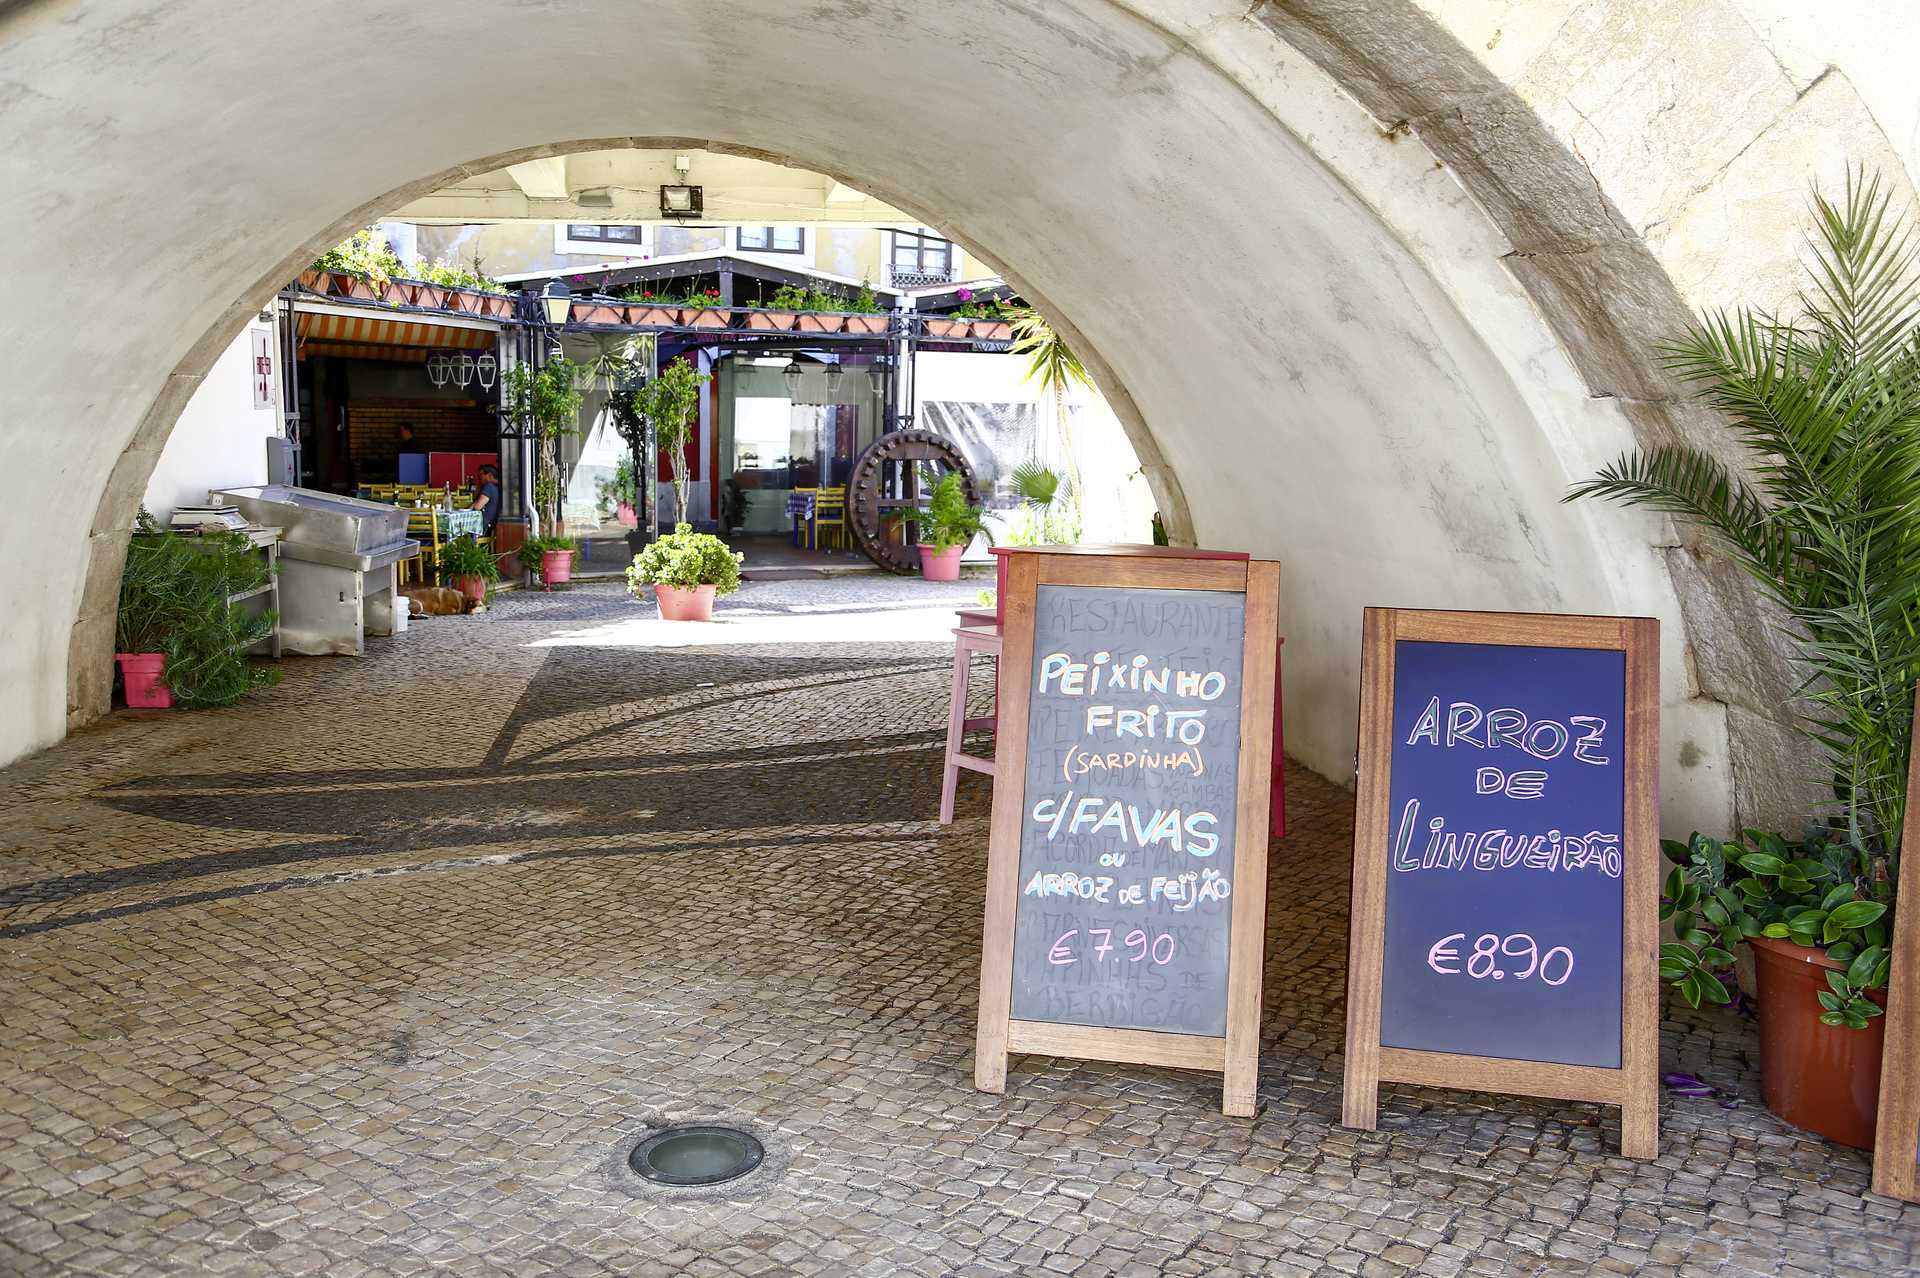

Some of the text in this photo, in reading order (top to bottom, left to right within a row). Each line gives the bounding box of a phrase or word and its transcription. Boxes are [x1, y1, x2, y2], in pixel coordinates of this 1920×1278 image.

[1406, 696, 1610, 765] ARROZ
[1476, 766, 1549, 799] DE
[1024, 870, 1114, 904] ARROZ
[1119, 884, 1146, 904] DE
[1428, 933, 1574, 986] €8.90
